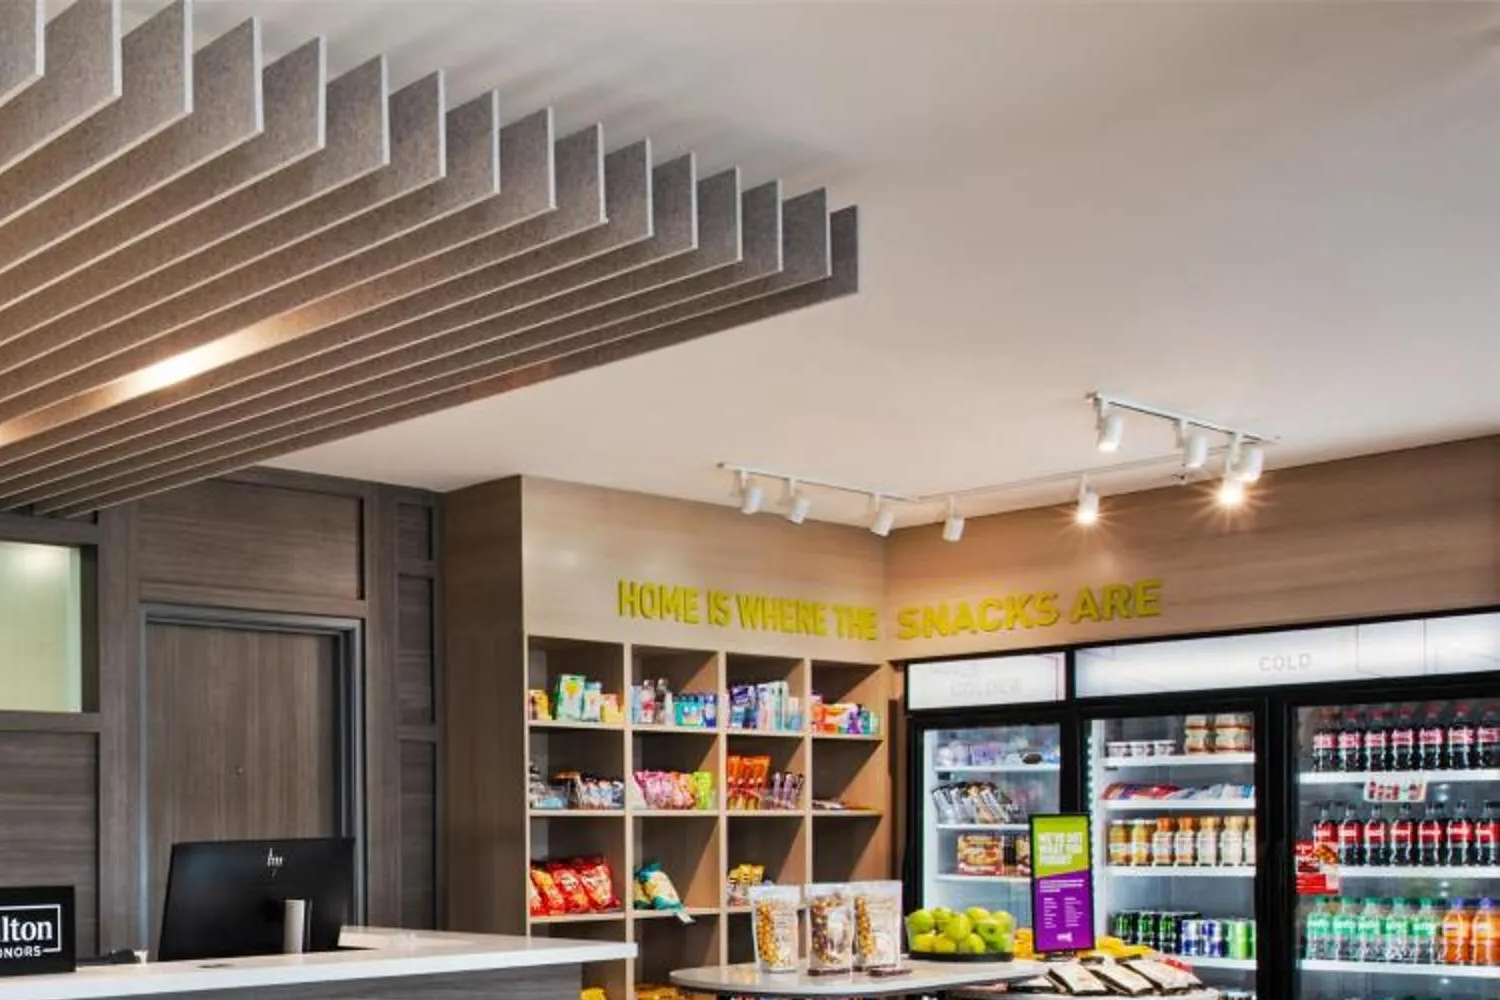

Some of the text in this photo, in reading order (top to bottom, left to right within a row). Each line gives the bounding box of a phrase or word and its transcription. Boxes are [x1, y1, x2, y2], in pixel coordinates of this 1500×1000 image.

[616, 579, 880, 642] HOME IS WHERE THE
[896, 577, 1164, 642] SNACKS ARE
[1258, 652, 1312, 672] COLD
